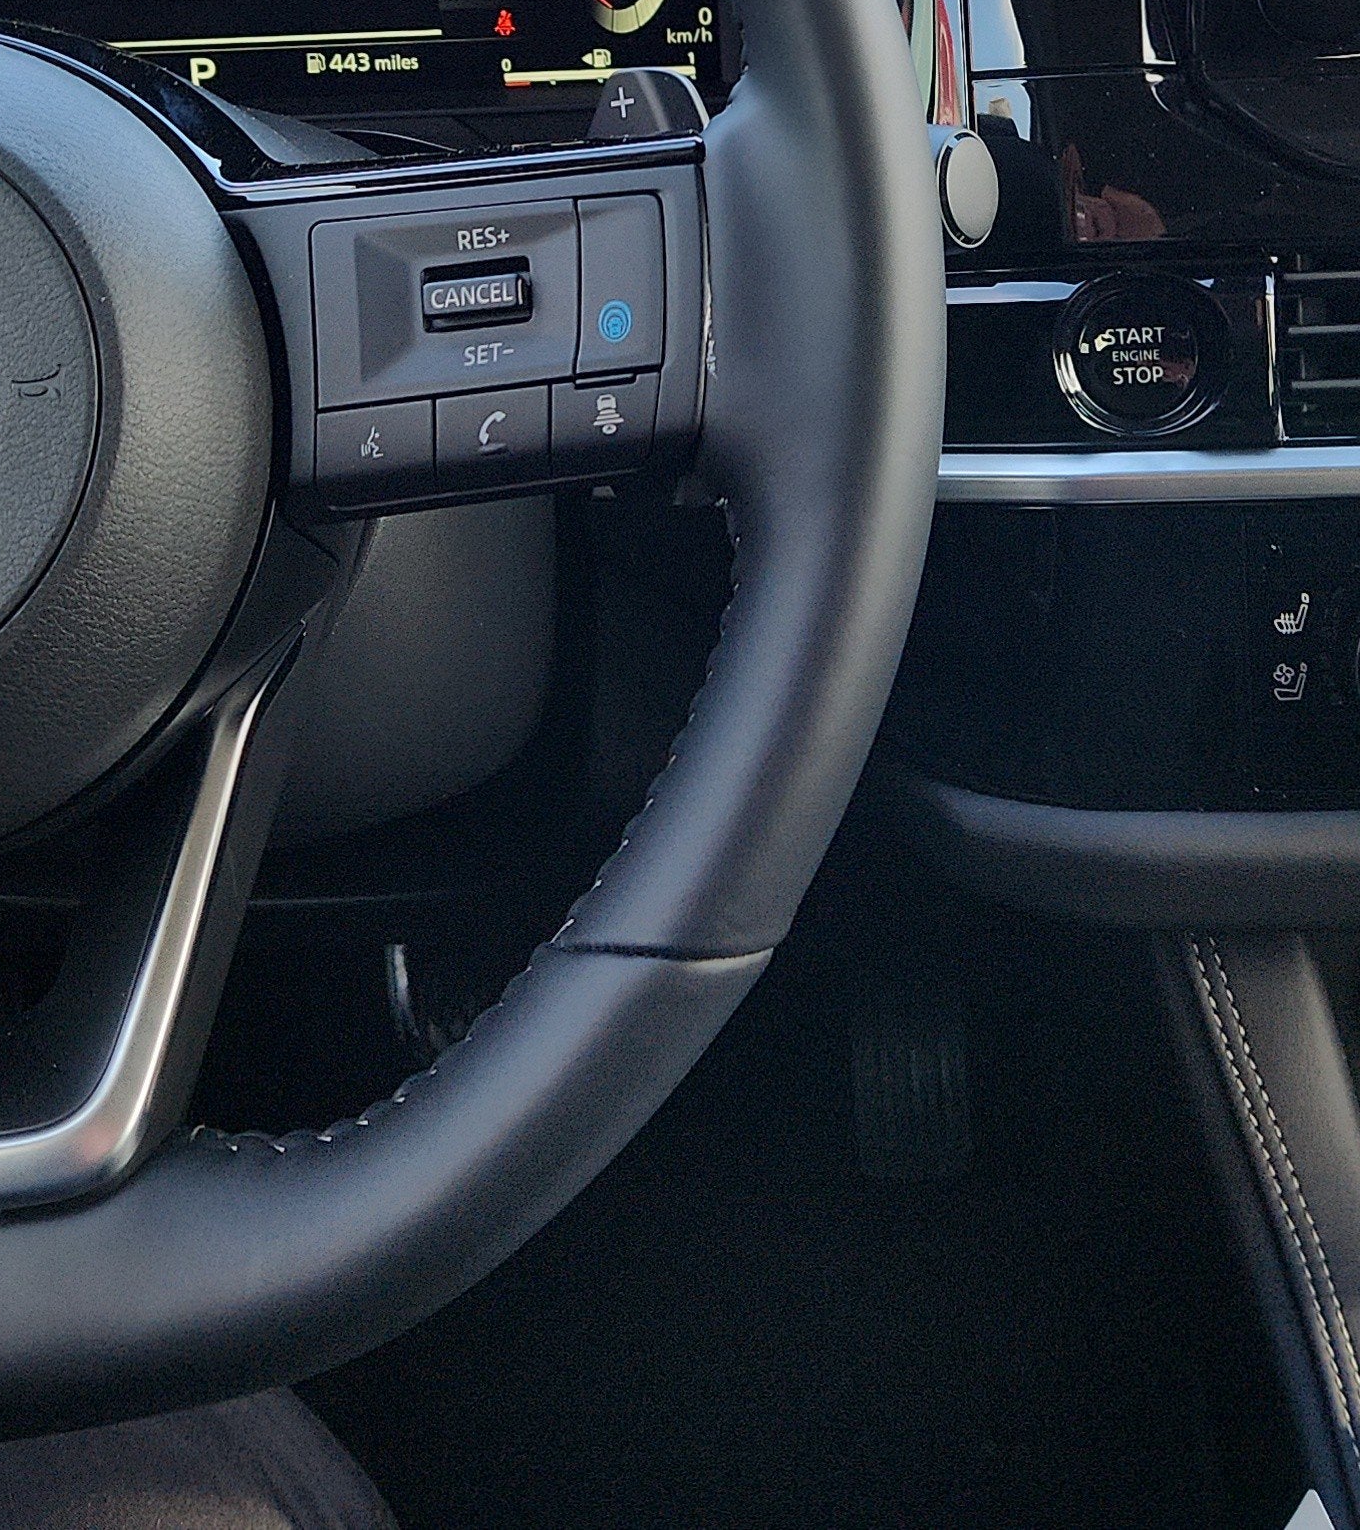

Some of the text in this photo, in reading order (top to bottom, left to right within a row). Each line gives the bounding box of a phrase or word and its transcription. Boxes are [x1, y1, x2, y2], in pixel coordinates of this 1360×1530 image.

[697, 6, 713, 26] 0
[666, 27, 714, 44] km/h
[190, 57, 217, 87] P
[329, 52, 419, 73] 443 miles
[500, 58, 513, 73] 0
[456, 228, 511, 252] RES+
[429, 282, 514, 311] CANCEL
[1105, 326, 1166, 345] START
[1112, 349, 1161, 363] ENGINE
[1112, 366, 1165, 385] STOP
